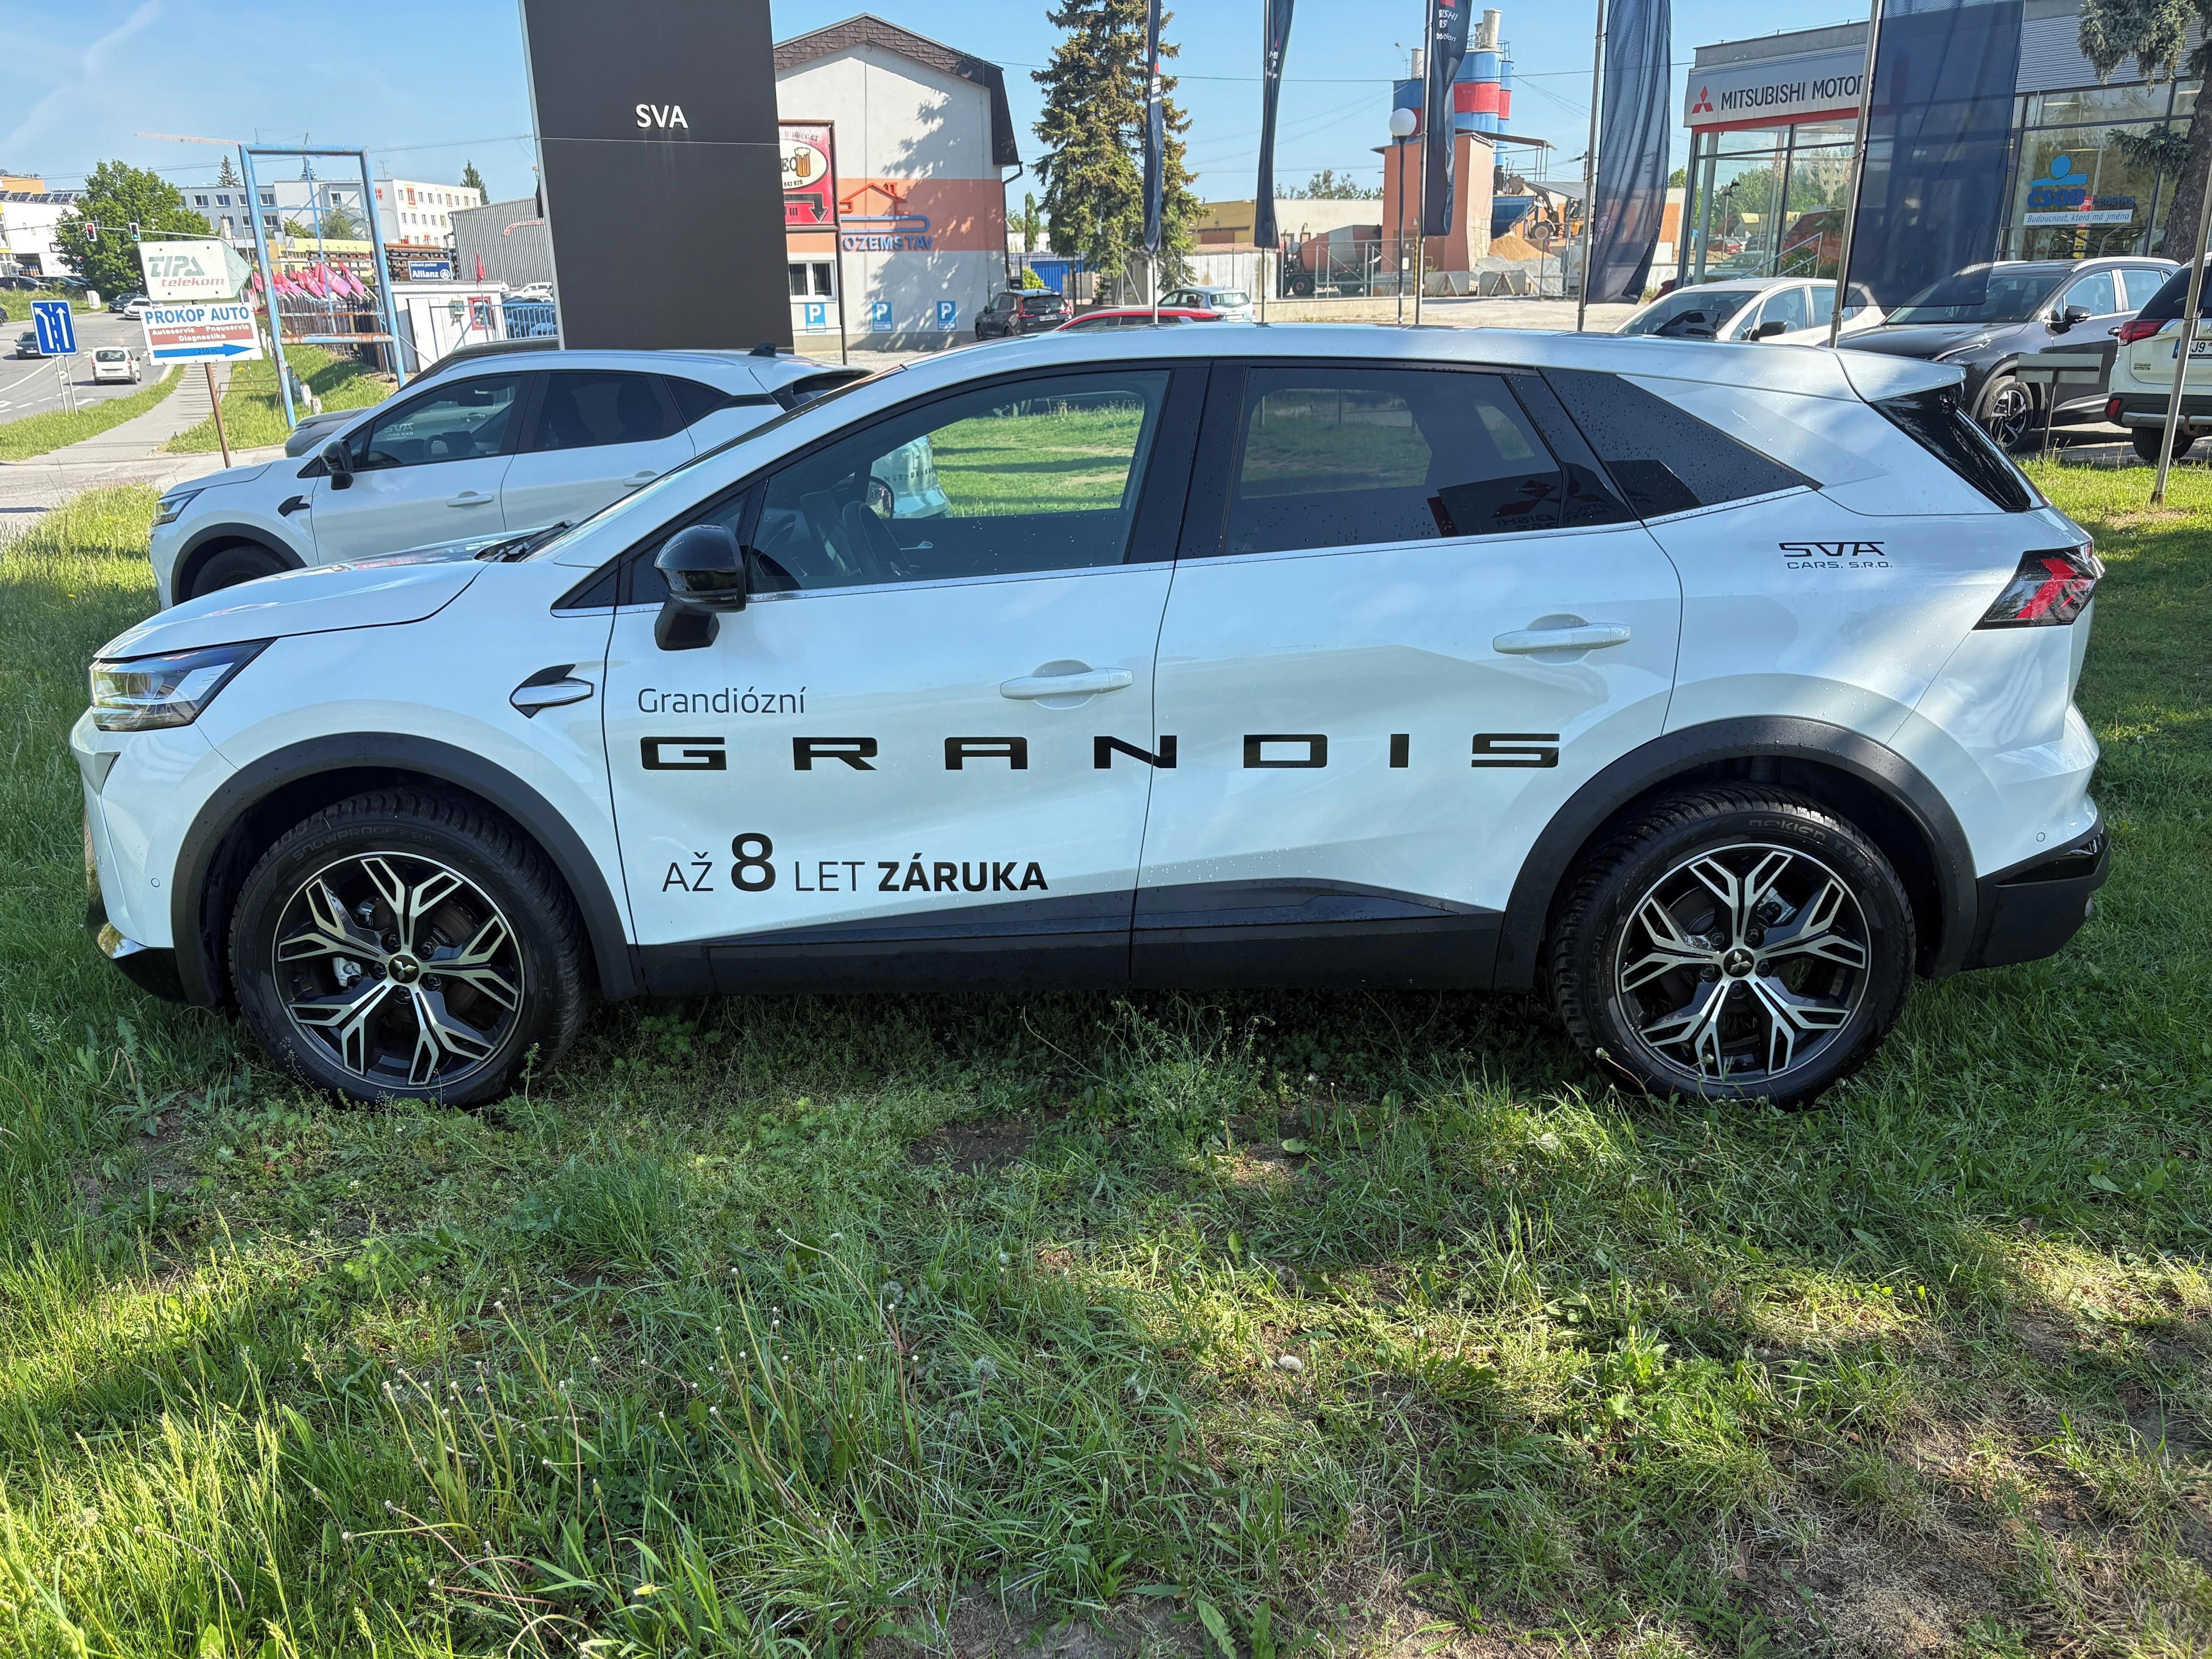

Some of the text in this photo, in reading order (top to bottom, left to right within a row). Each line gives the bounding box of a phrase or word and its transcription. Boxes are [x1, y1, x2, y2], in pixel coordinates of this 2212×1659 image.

[1721, 82, 1805, 110] MITSUBISHI
[636, 104, 689, 128] SVA
[2027, 212, 2129, 222] Budoucnost, která má jméno
[844, 235, 933, 251] OZEMSTAV
[148, 255, 205, 277] TIPA
[161, 277, 225, 287] telekom
[145, 306, 249, 324] PROKOP AUTO
[810, 304, 821, 322] P
[876, 304, 888, 320] P
[941, 303, 952, 319] P
[152, 324, 249, 335] Autoservis Pneuservis
[178, 333, 226, 342] Diagnostika
[2191, 342, 2206, 353] J9
[1778, 542, 1886, 557] SVA
[638, 686, 806, 713] Grandiózní
[640, 733, 1560, 771] GRANDIS
[662, 833, 1049, 892] AŽ 8 LET ZÁRUKA
